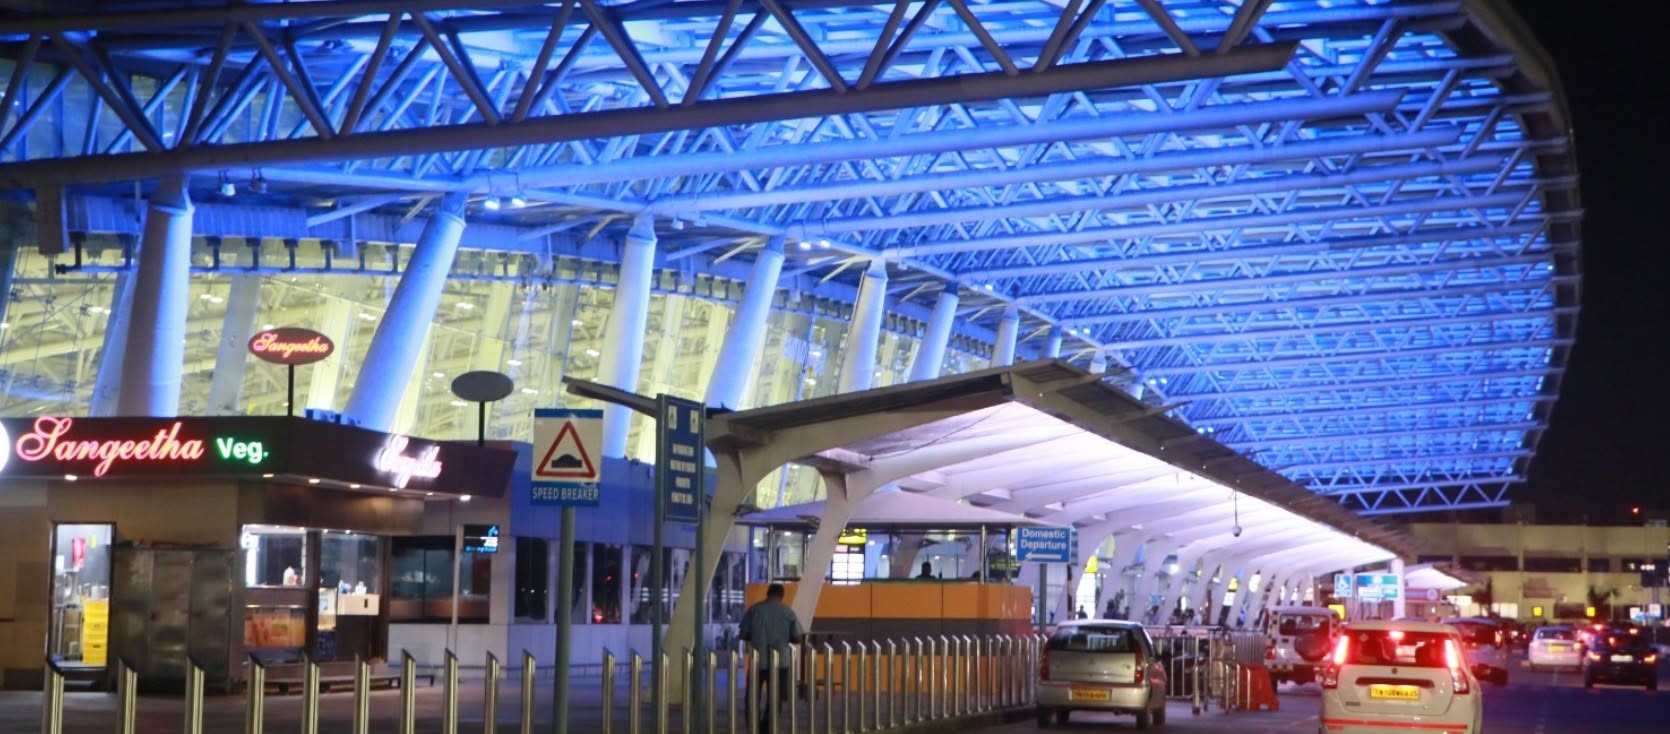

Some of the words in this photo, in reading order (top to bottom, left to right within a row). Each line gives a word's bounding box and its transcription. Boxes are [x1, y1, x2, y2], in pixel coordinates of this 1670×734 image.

[253, 333, 329, 358] Sangeetha
[16, 415, 204, 477] Sangeetha
[217, 438, 269, 463] Veg.
[533, 487, 559, 500] SPEED
[561, 487, 599, 501] BREAKER
[1022, 528, 1065, 538] Domestic
[1020, 539, 1066, 551] Departure
